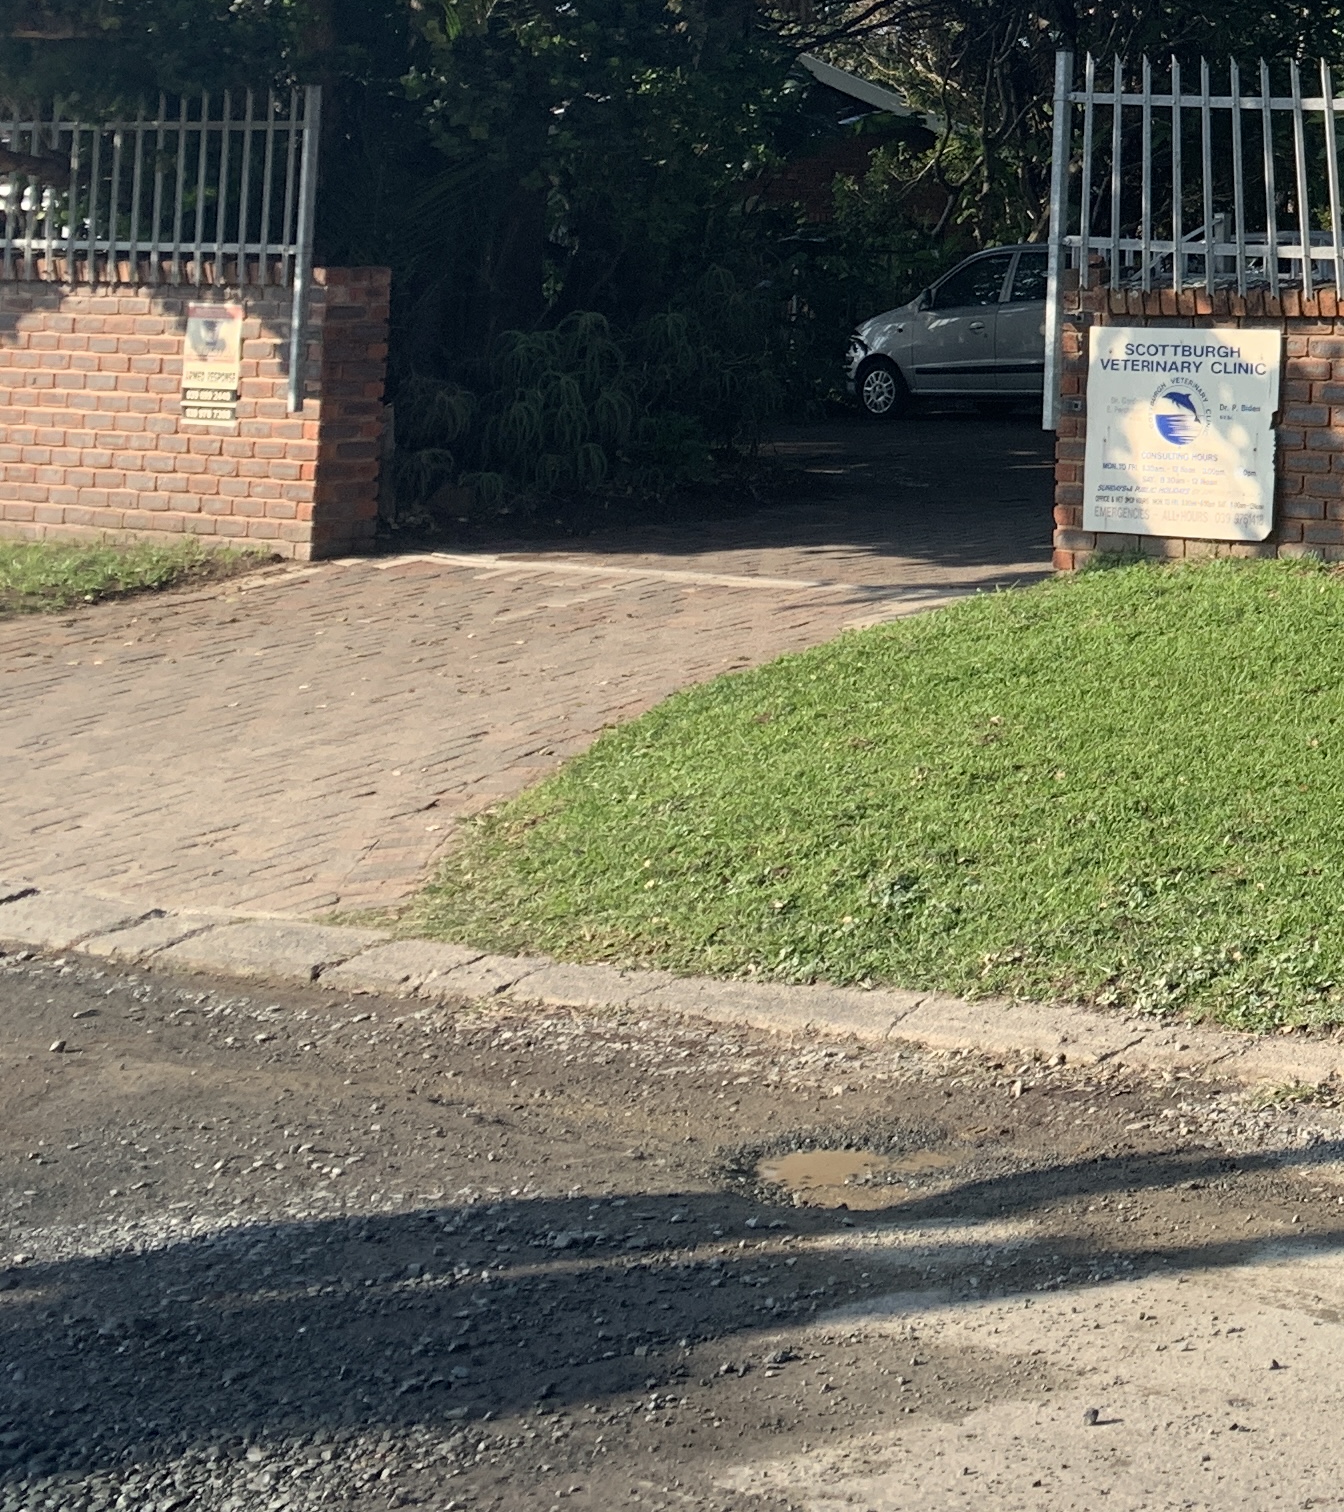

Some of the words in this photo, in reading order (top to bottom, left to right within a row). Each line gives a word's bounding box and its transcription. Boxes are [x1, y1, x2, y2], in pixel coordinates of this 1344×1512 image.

[1124, 343, 1241, 358] SCOTTBURGH
[1100, 359, 1204, 374] VETERINARY
[1210, 361, 1267, 376] CLINIC
[1141, 451, 1190, 462] CONSULTING
[1192, 452, 1219, 463] HOURS
[1094, 506, 1150, 520] EMERGENCIES
